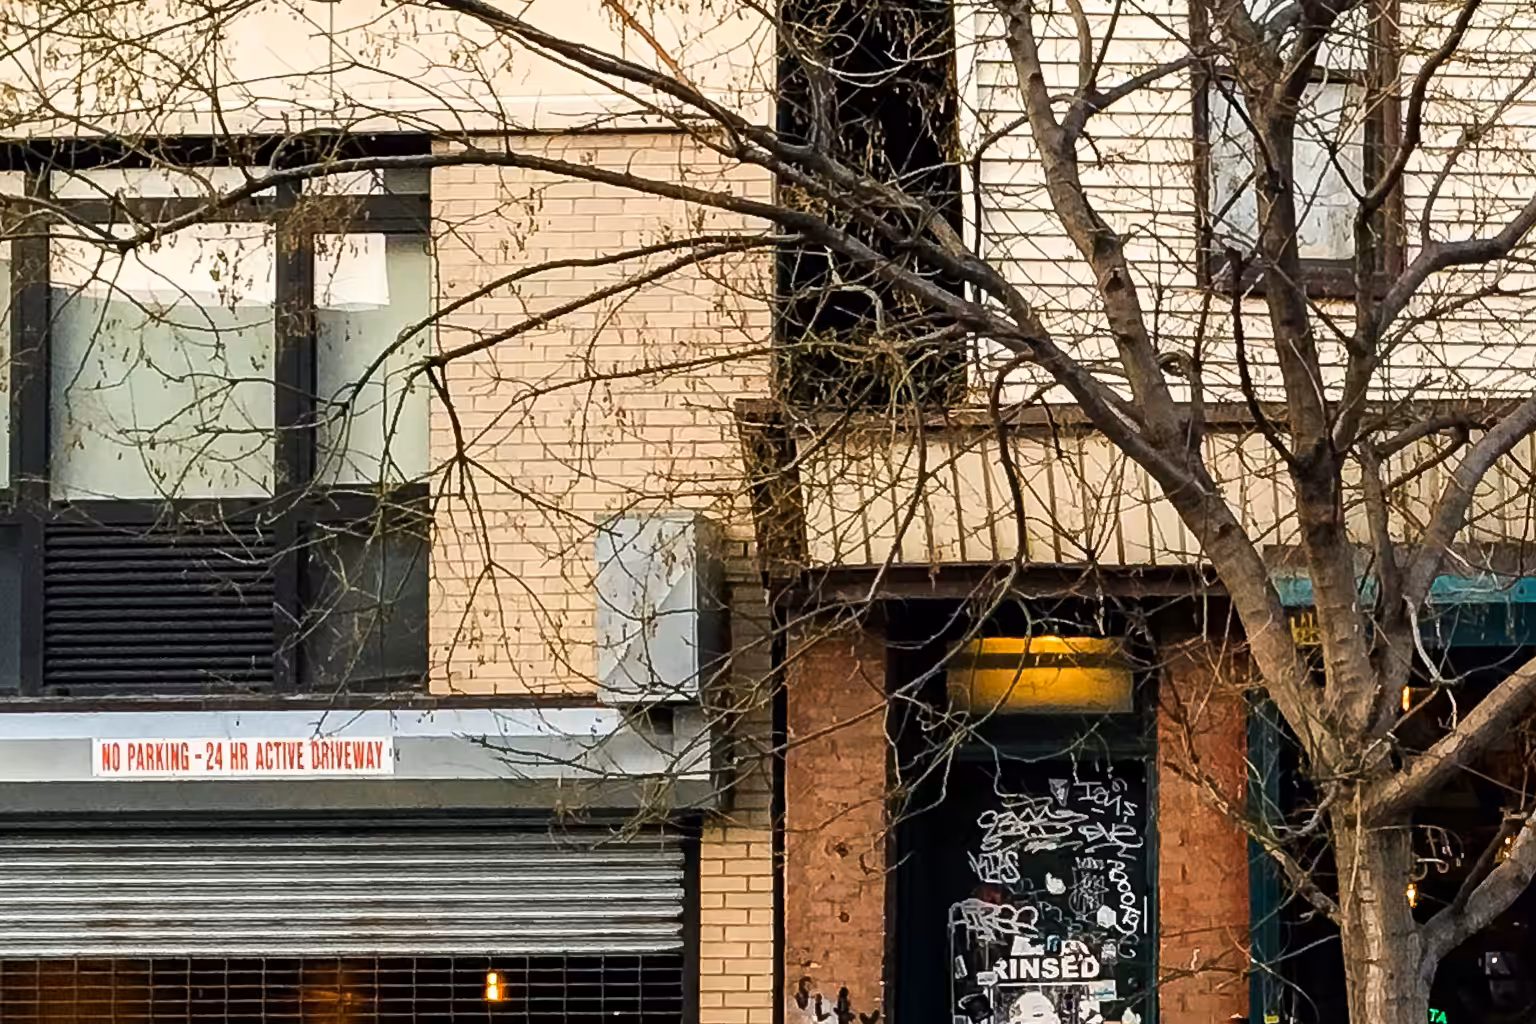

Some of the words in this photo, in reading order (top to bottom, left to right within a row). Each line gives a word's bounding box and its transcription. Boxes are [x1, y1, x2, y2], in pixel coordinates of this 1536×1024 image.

[102, 743, 120, 771] NO
[127, 742, 190, 771] PARKING
[206, 742, 223, 770] 24
[230, 742, 249, 770] HR
[255, 741, 305, 770] ACTIVE
[311, 741, 384, 770] DRIVEWAY
[993, 954, 1100, 979] RINSED
